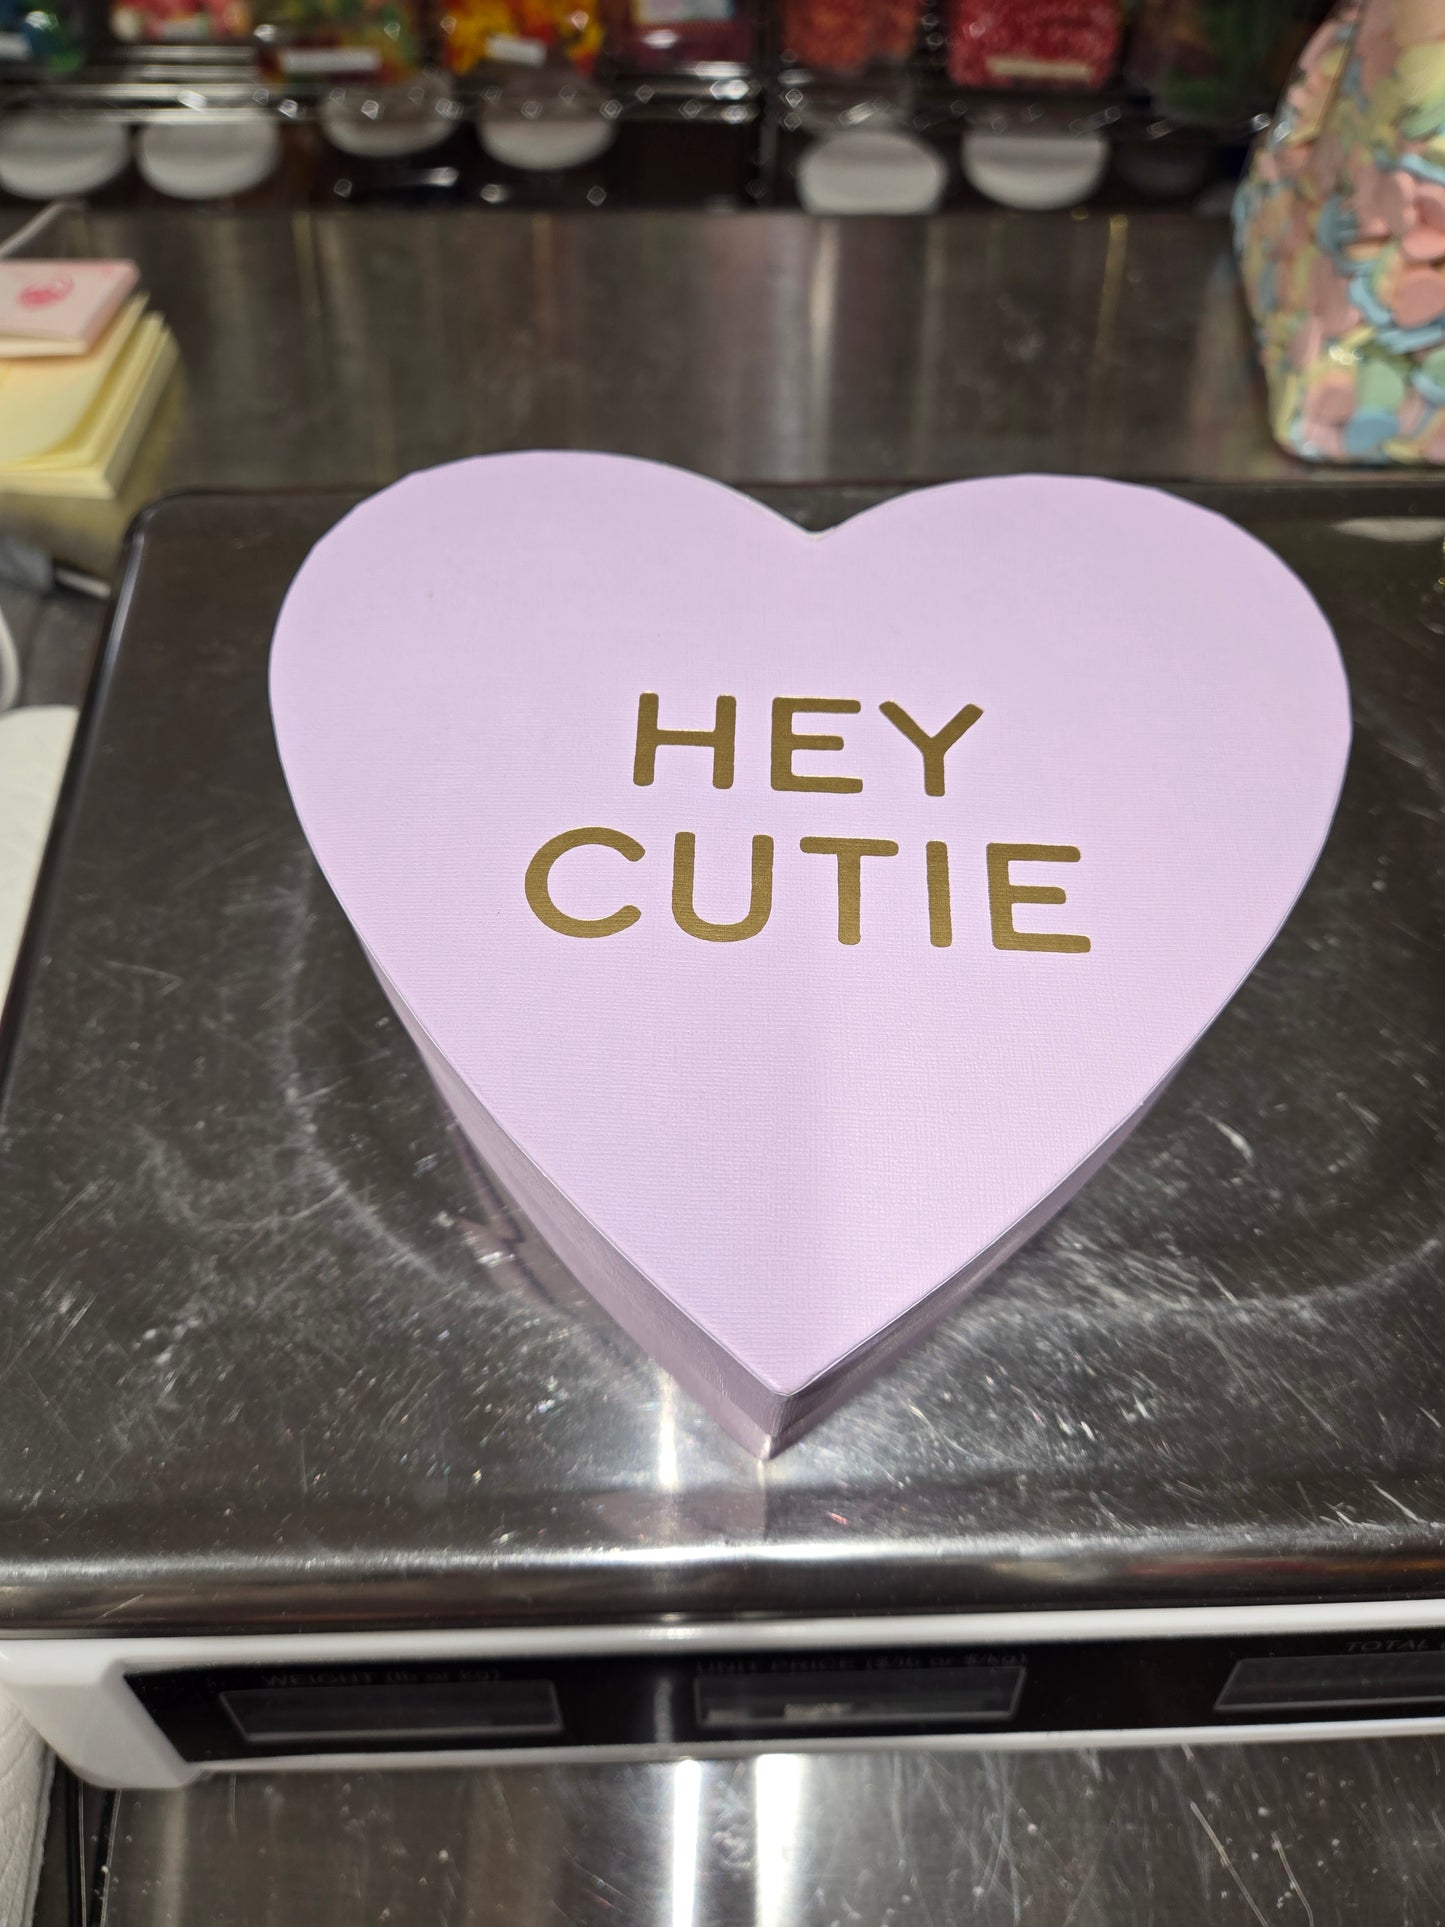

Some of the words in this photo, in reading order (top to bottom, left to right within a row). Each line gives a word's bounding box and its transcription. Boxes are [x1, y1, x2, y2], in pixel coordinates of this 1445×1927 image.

[633, 692, 984, 797] HEY
[525, 827, 1091, 953] CUTIE
[1346, 1639, 1430, 1652] TOTAL
